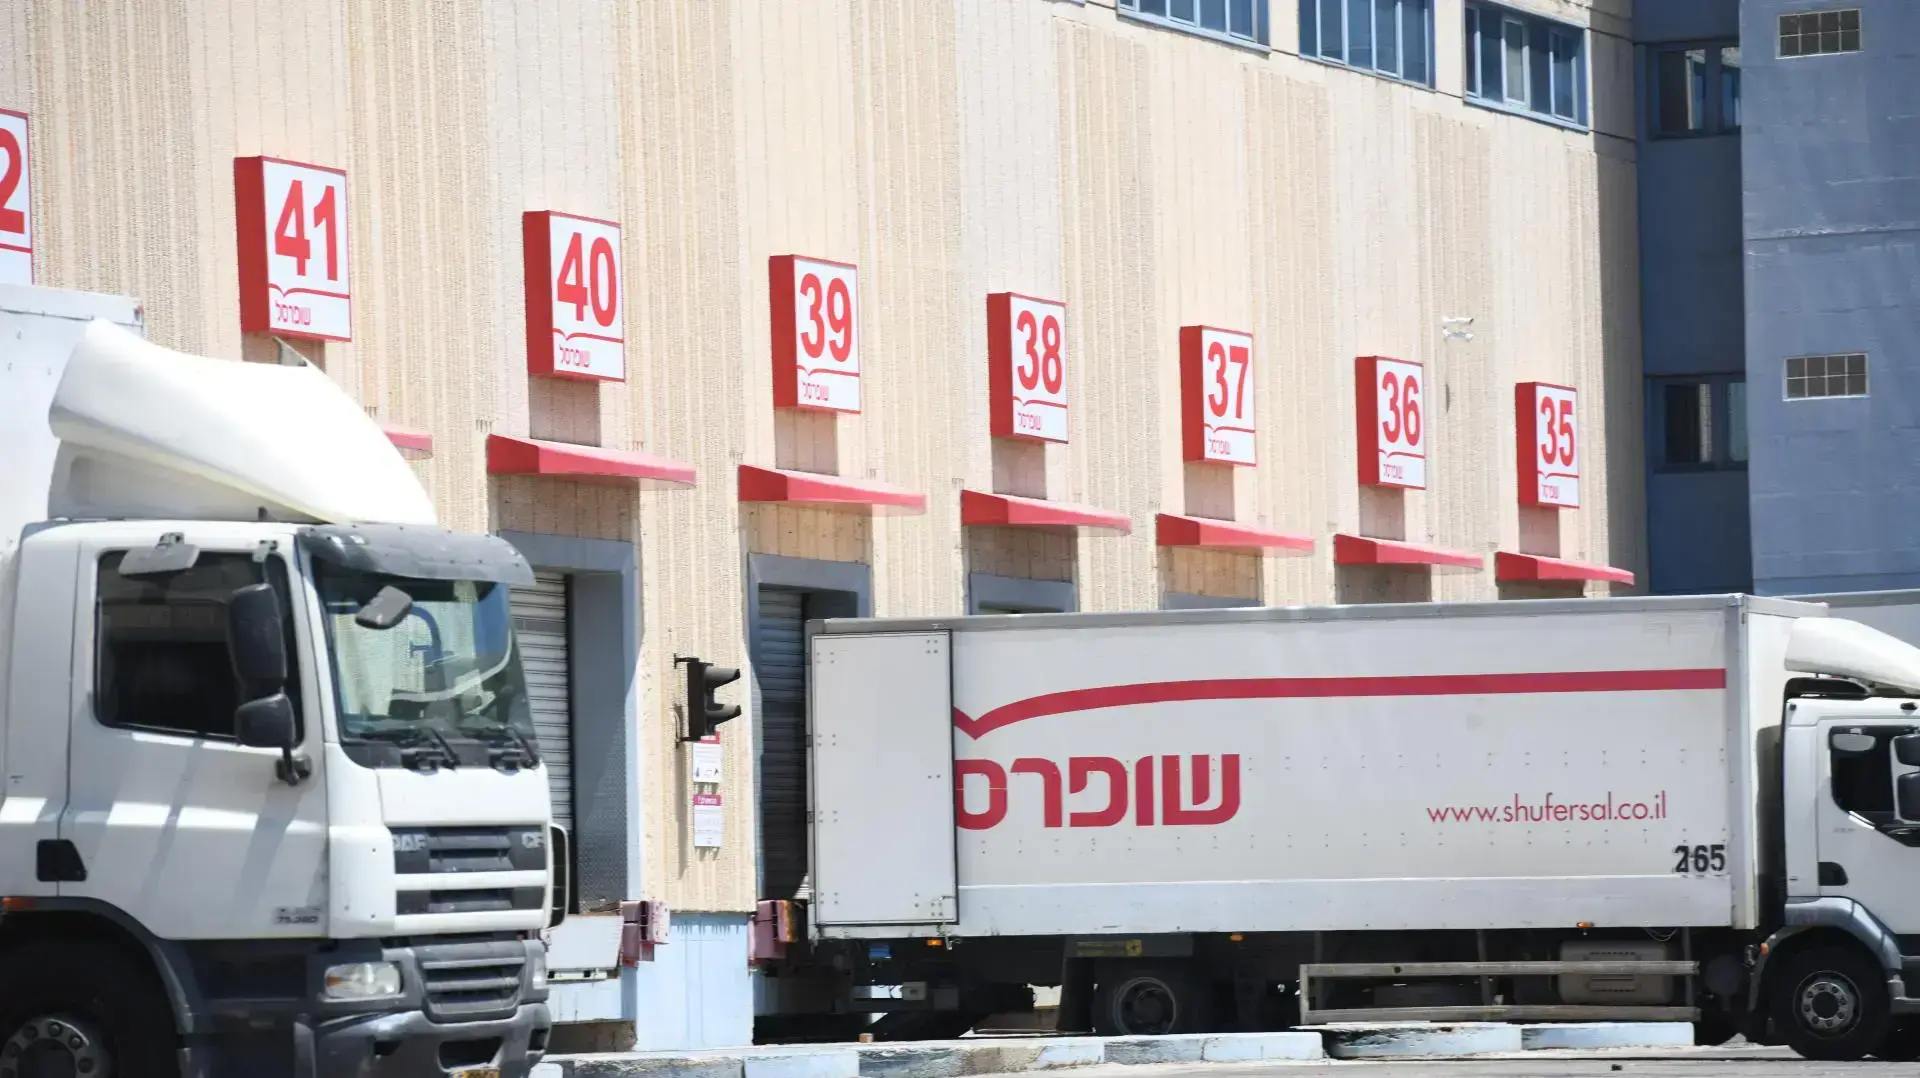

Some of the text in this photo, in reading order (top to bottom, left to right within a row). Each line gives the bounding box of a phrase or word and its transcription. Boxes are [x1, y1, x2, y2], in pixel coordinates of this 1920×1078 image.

[275, 180, 338, 280] 41
[275, 299, 312, 326] שופרסל
[557, 231, 618, 327] 40
[800, 272, 852, 362] 39
[1017, 310, 1062, 394] 38
[558, 345, 591, 368] שופרסל
[801, 382, 829, 401] שופרסל
[1207, 341, 1249, 418] 37
[1016, 412, 1042, 431] שופרסל
[1382, 372, 1421, 446] 36
[1540, 396, 1575, 467] 35
[1427, 790, 1668, 823] www.shufersal.co.il
[1673, 844, 1727, 873] 265
